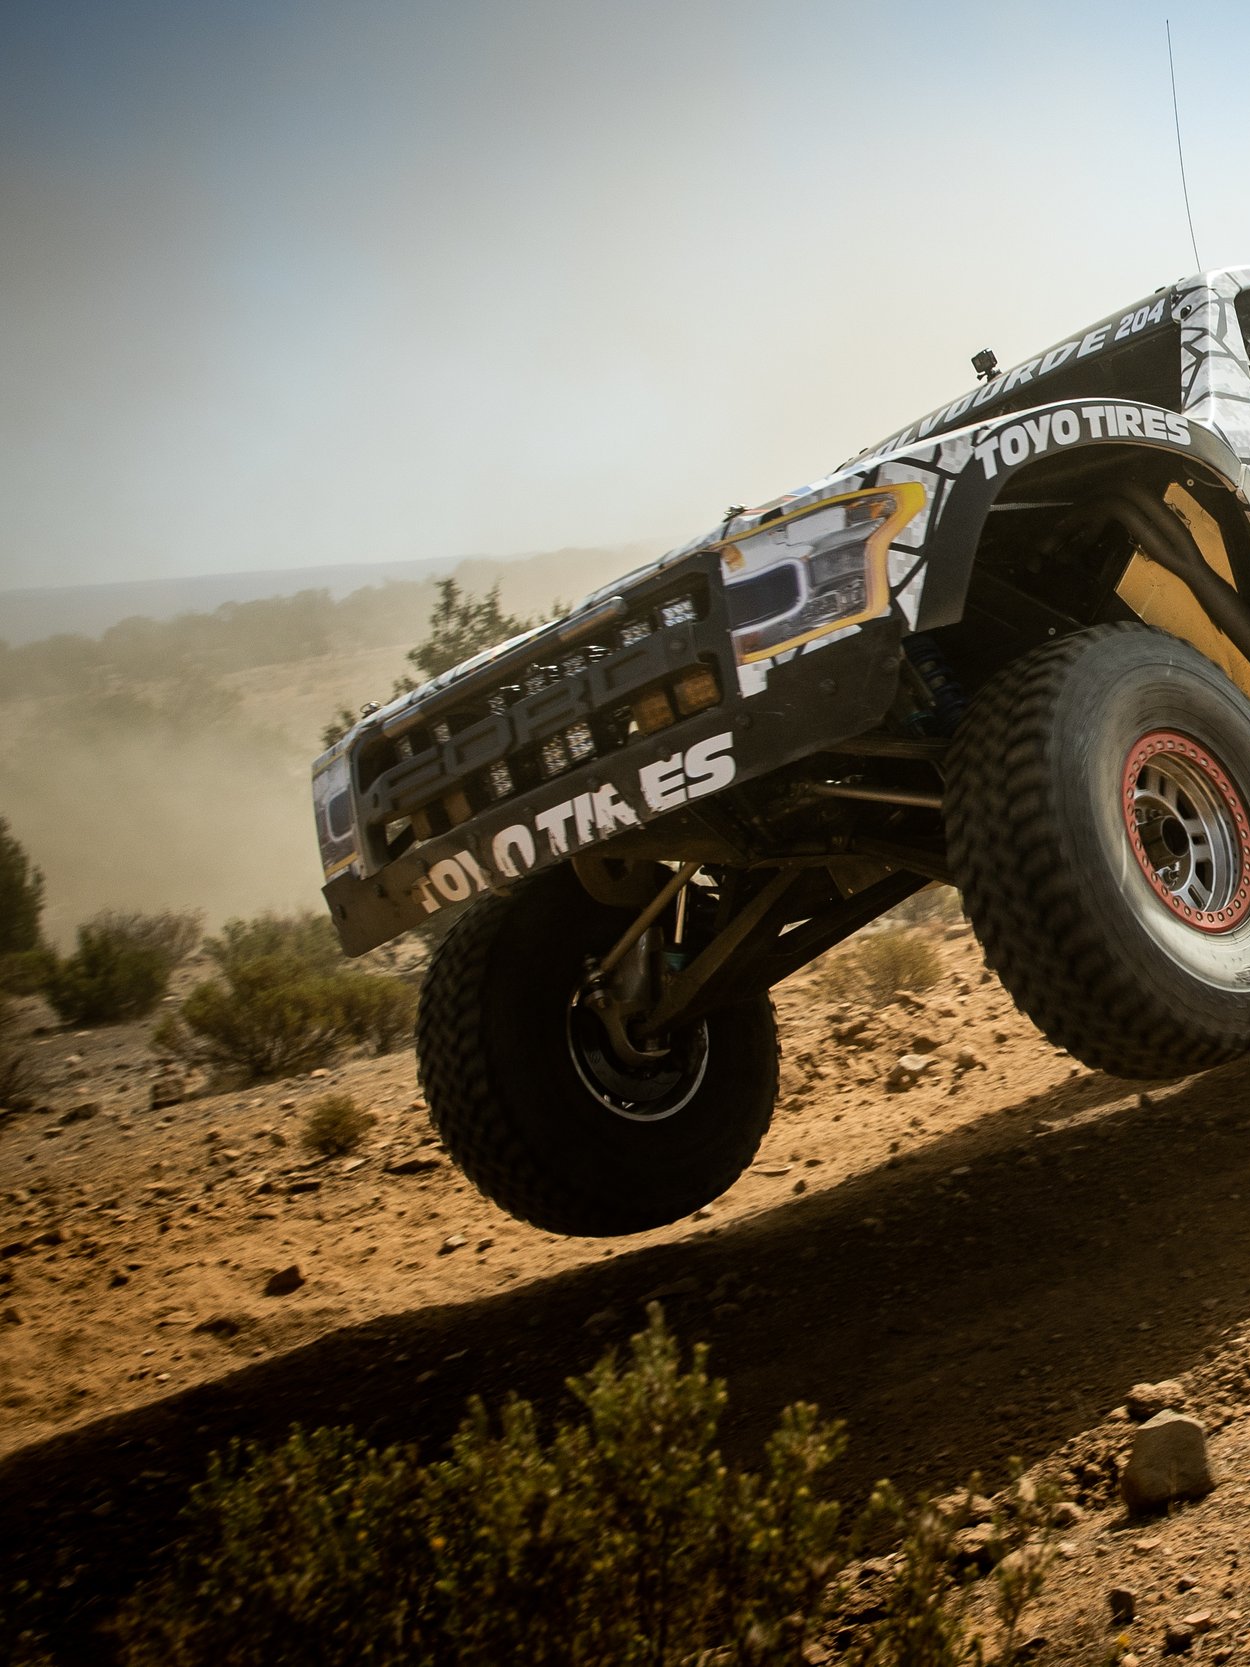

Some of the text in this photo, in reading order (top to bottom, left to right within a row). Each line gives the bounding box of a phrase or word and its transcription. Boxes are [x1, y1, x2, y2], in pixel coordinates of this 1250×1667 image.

[1114, 299, 1166, 341] 204
[975, 405, 1192, 480] TOYO TIRES
